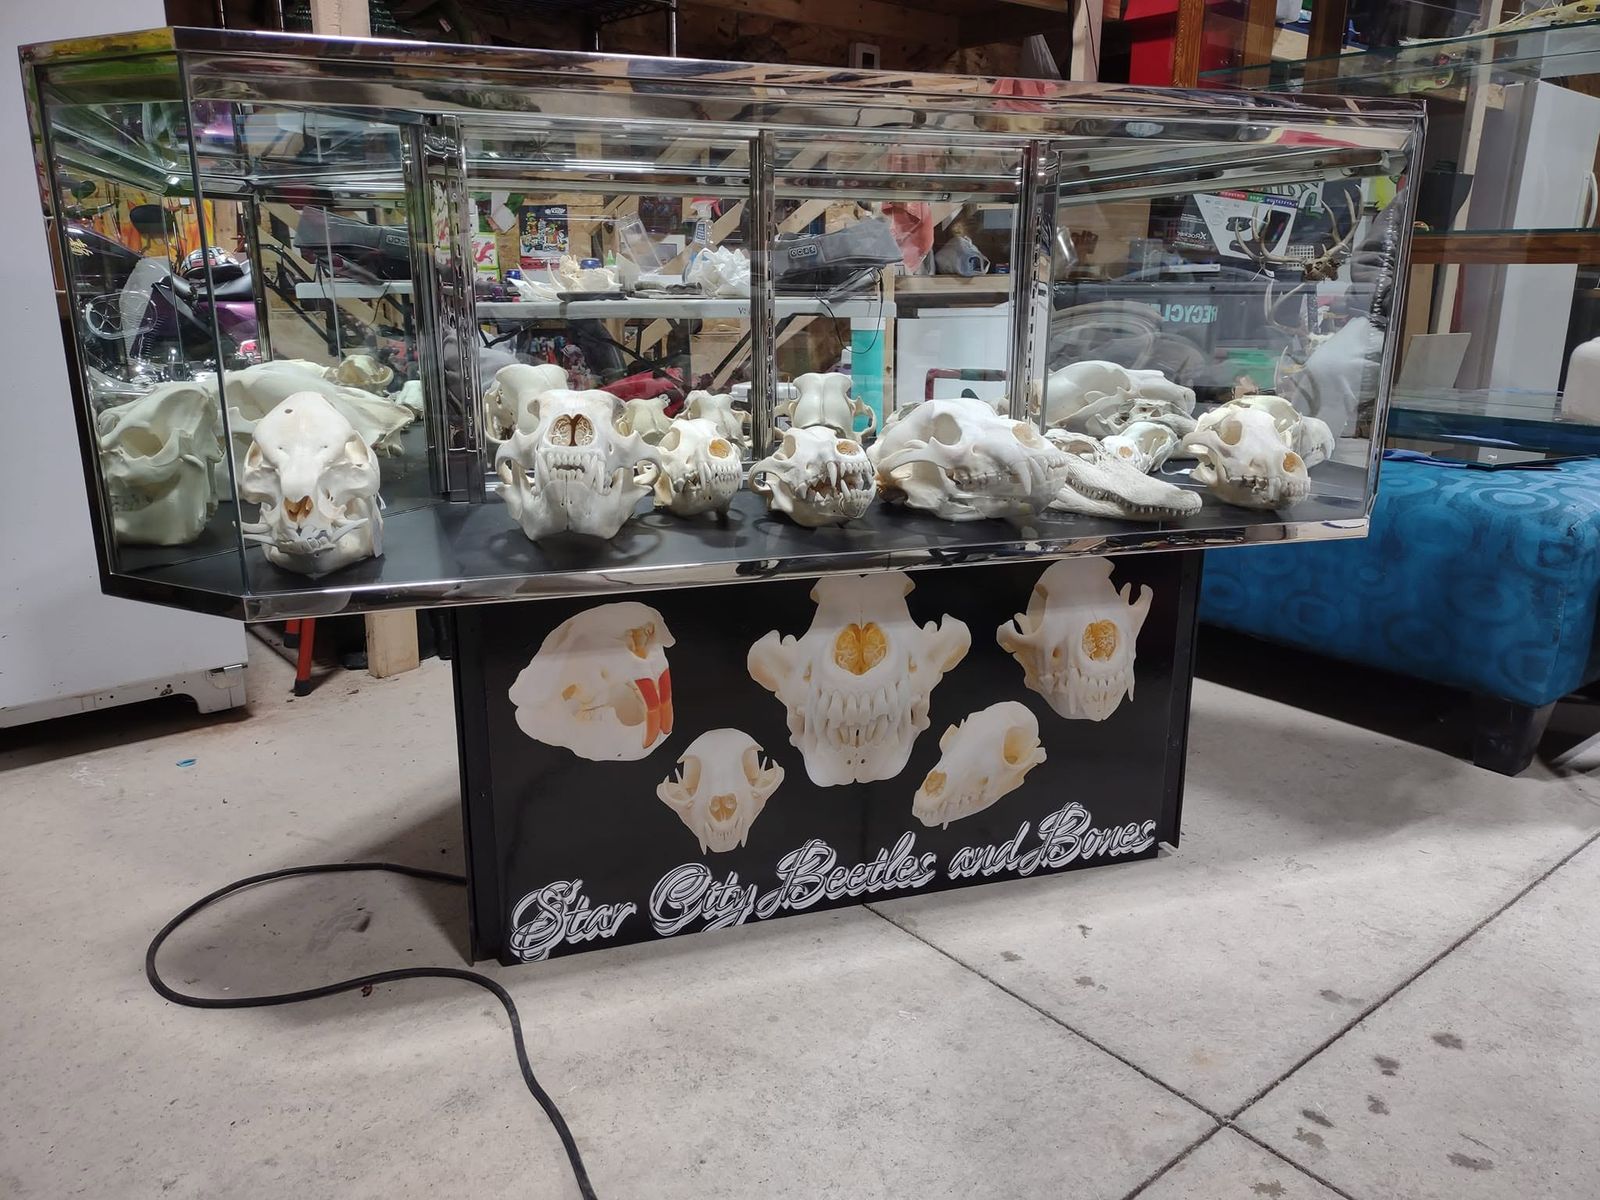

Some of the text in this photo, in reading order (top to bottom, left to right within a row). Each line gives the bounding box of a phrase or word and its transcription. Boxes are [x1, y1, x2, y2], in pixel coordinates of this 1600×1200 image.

[510, 802, 1156, 963] Star City Beetles and Bones
